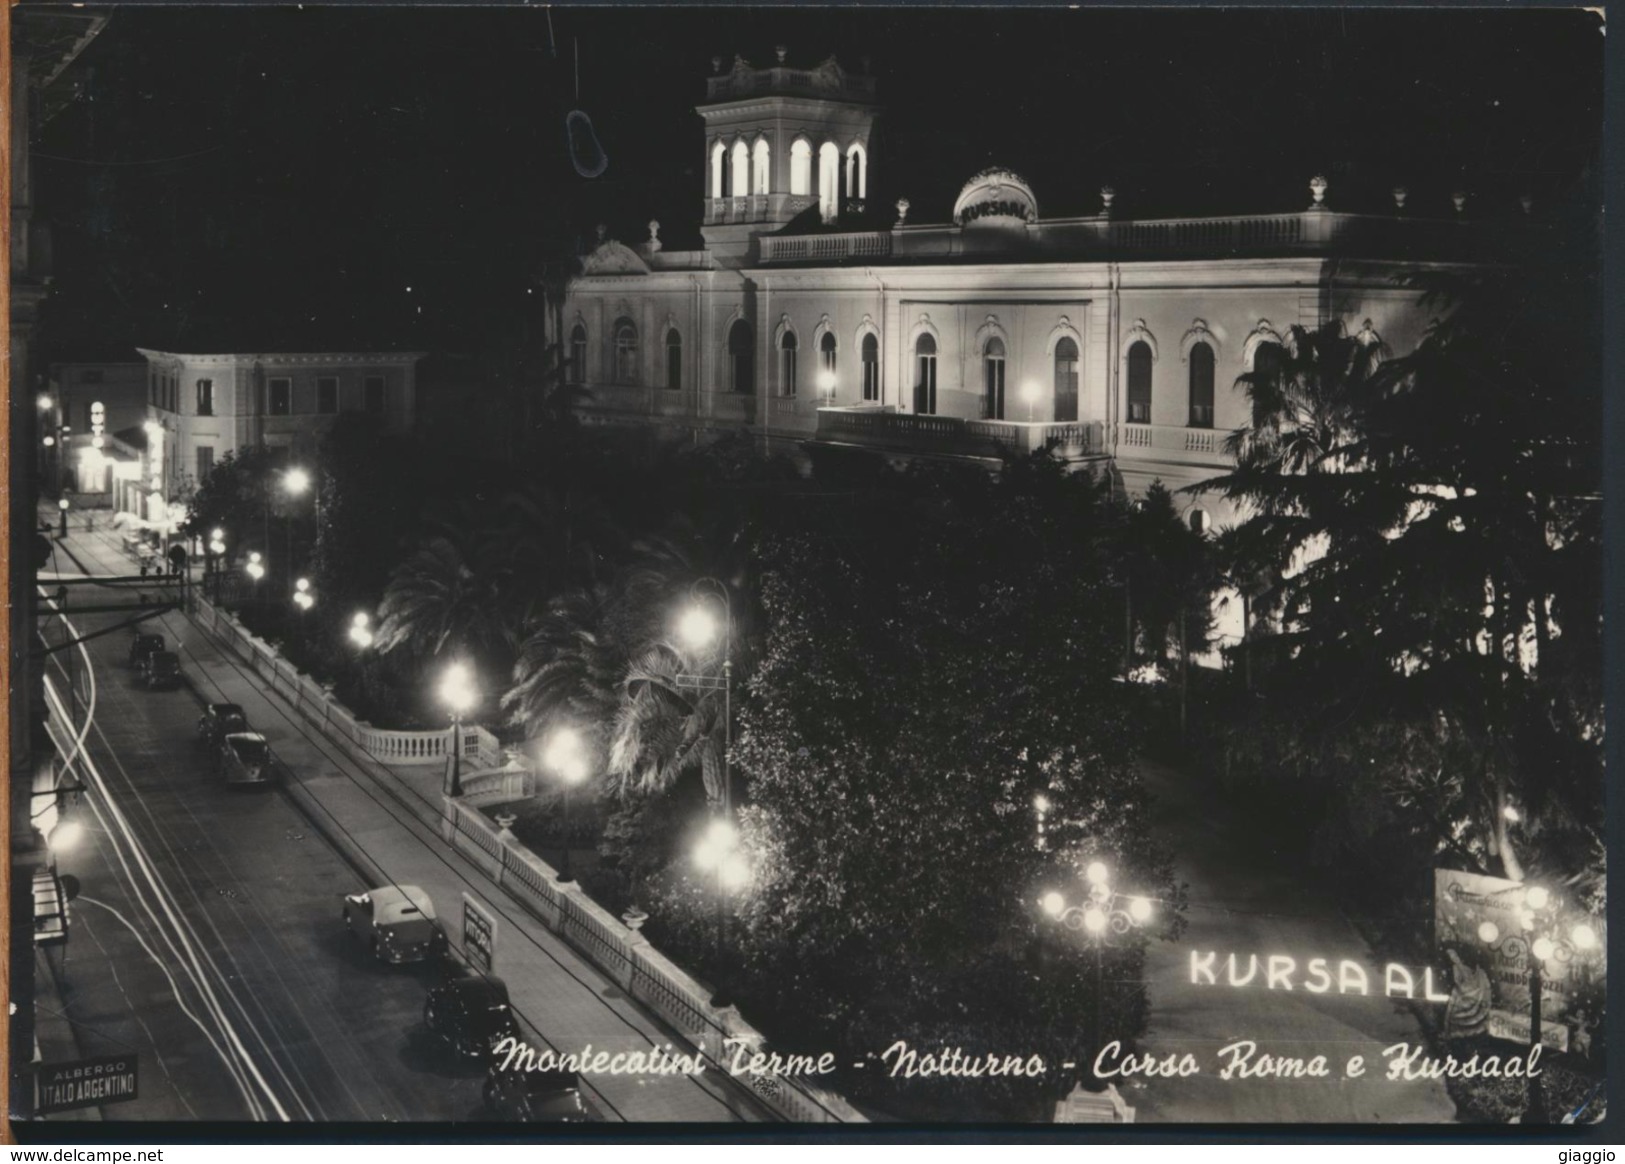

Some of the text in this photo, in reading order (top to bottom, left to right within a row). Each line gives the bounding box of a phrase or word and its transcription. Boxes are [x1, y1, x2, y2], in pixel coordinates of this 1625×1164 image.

[1190, 950, 1450, 1001] KURSAAL
[54, 1062, 126, 1081] ALBERGO
[77, 1073, 134, 1101] ARGENTINO
